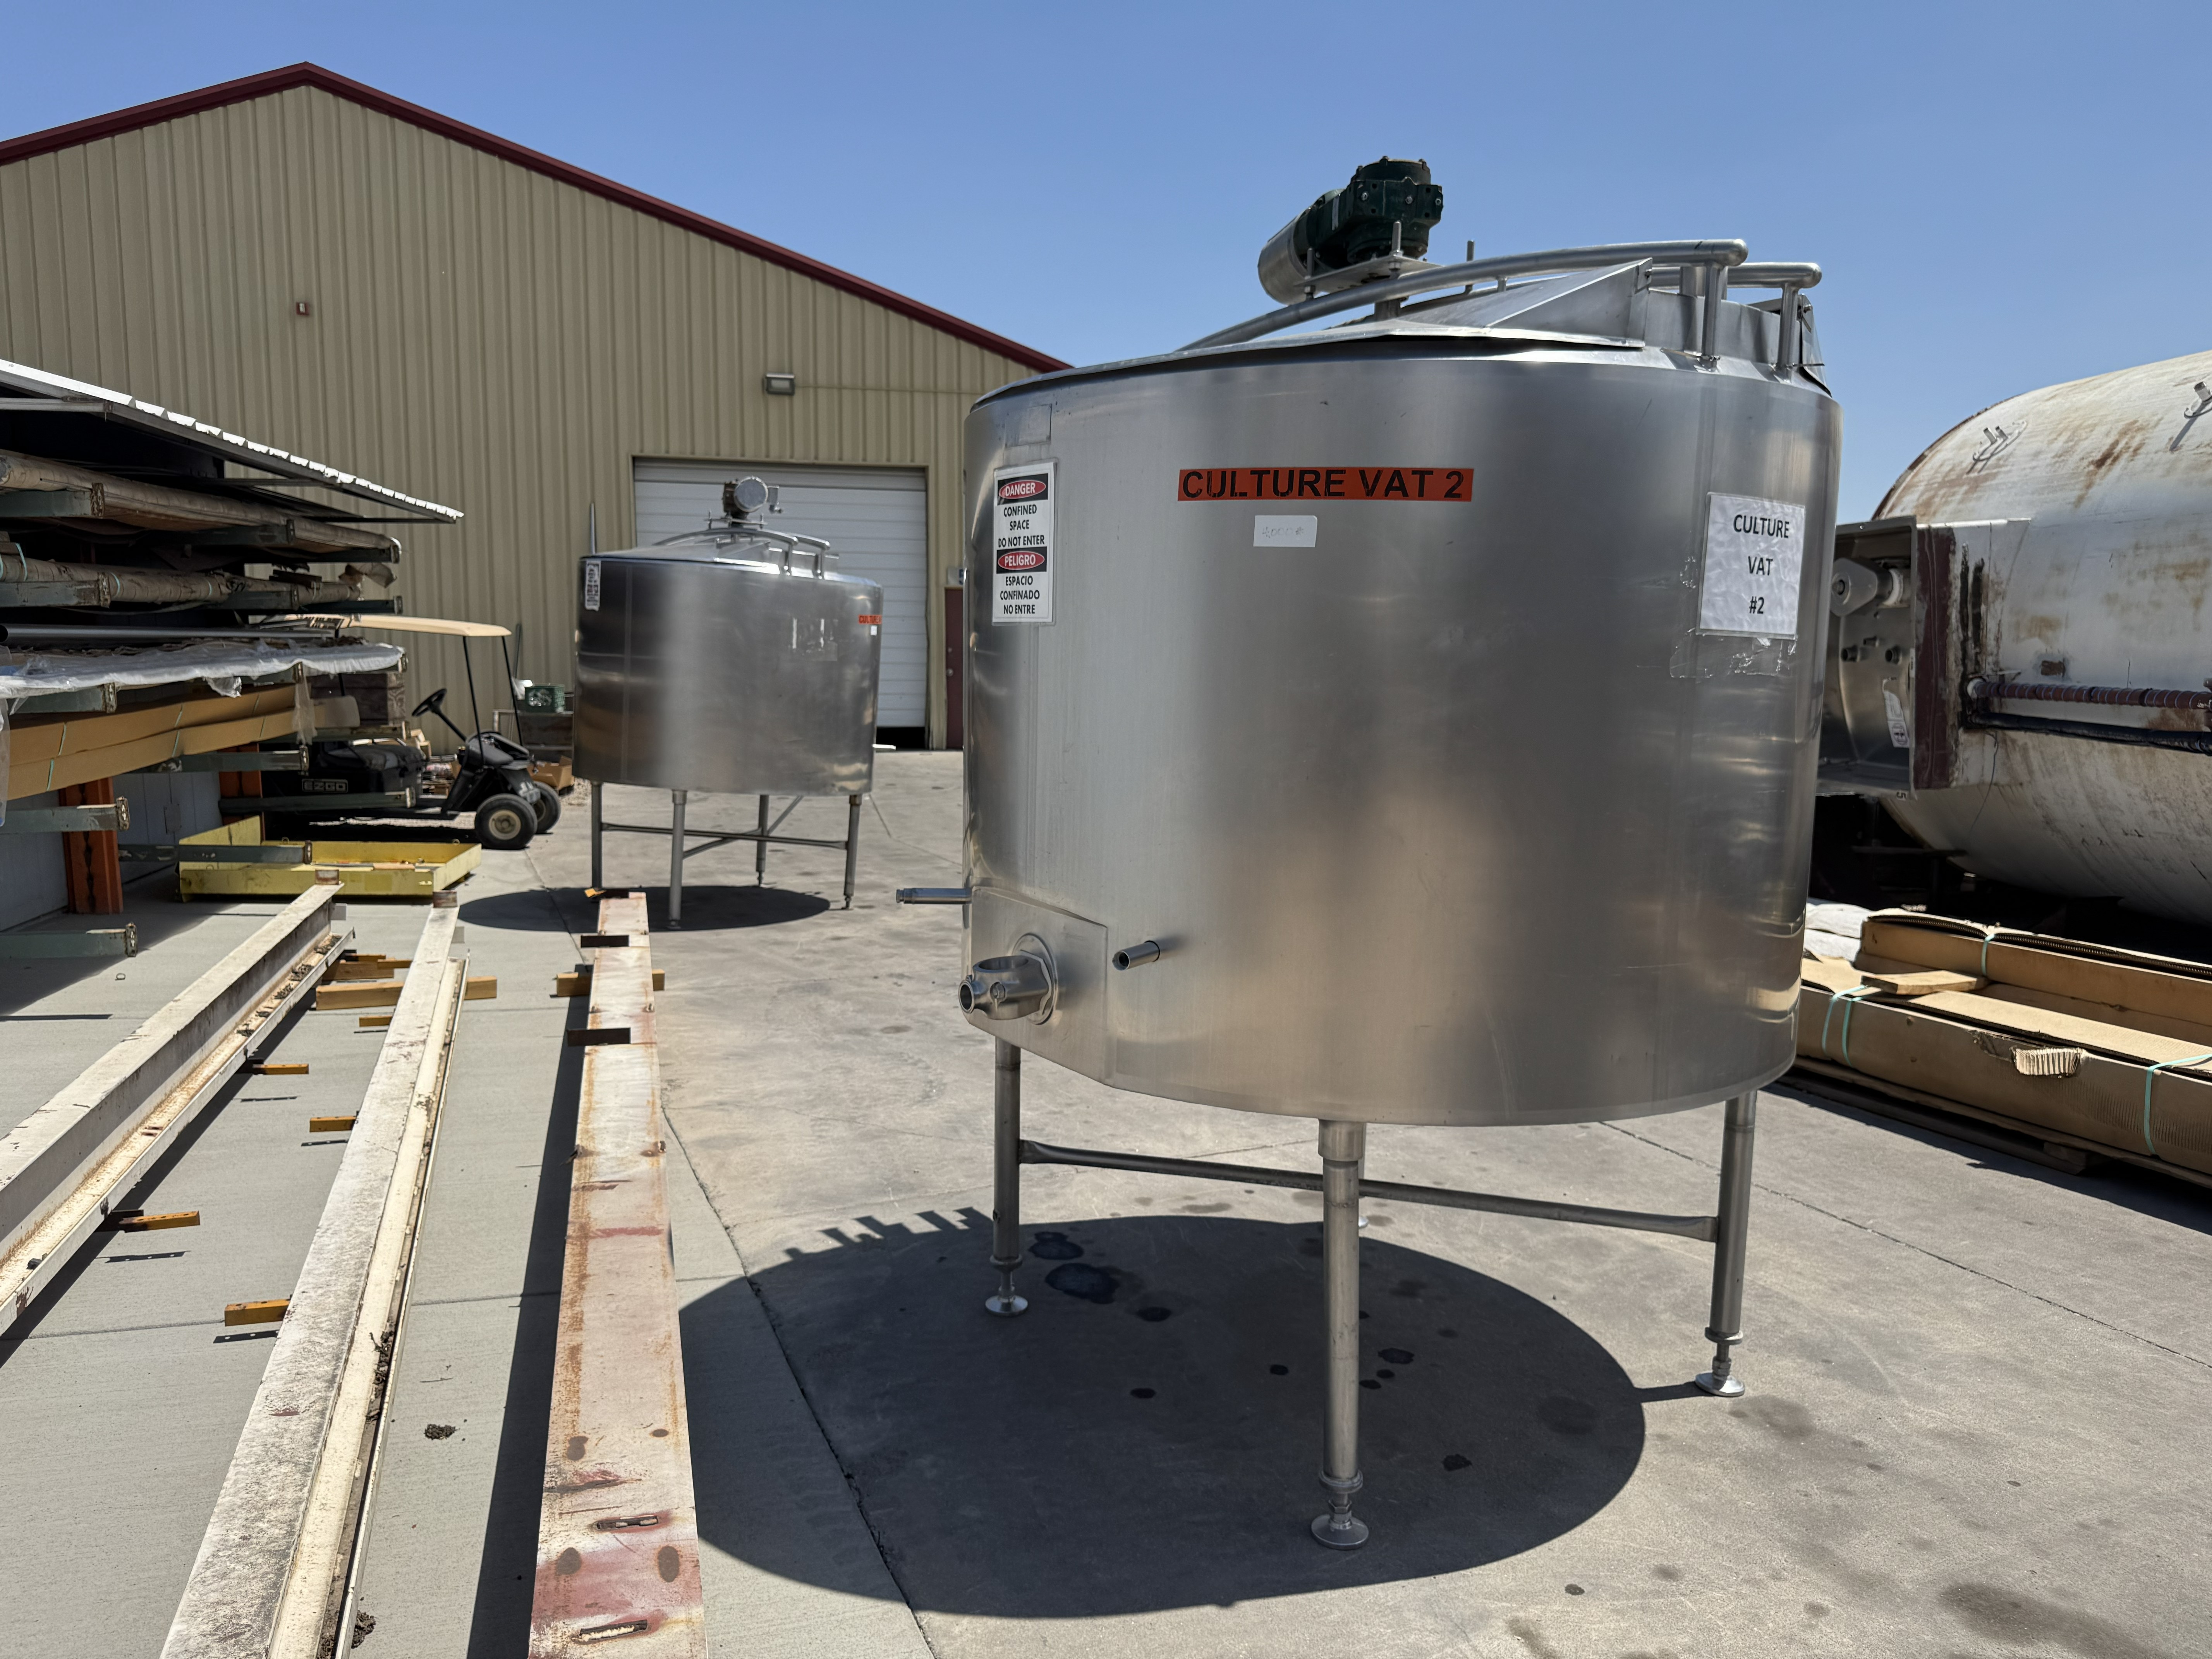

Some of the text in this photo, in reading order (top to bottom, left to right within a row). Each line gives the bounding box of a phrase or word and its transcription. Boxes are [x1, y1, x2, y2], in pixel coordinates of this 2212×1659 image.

[1005, 483, 1036, 496] DANGER
[1183, 470, 1464, 498] CULTURE VAT 2
[1003, 504, 1037, 517] CONFINED
[1010, 520, 1029, 531] SPACE
[1733, 514, 1790, 539] CULTURE
[998, 535, 1044, 548] DO NOT ENTER
[1005, 554, 1036, 567] PELIGRO
[1748, 556, 1773, 575] VAT
[1005, 575, 1033, 586] ESPACIO
[1000, 589, 1040, 600] CONFINADO
[1004, 605, 1035, 614] NO ENTRE
[1749, 596, 1764, 614] #2
